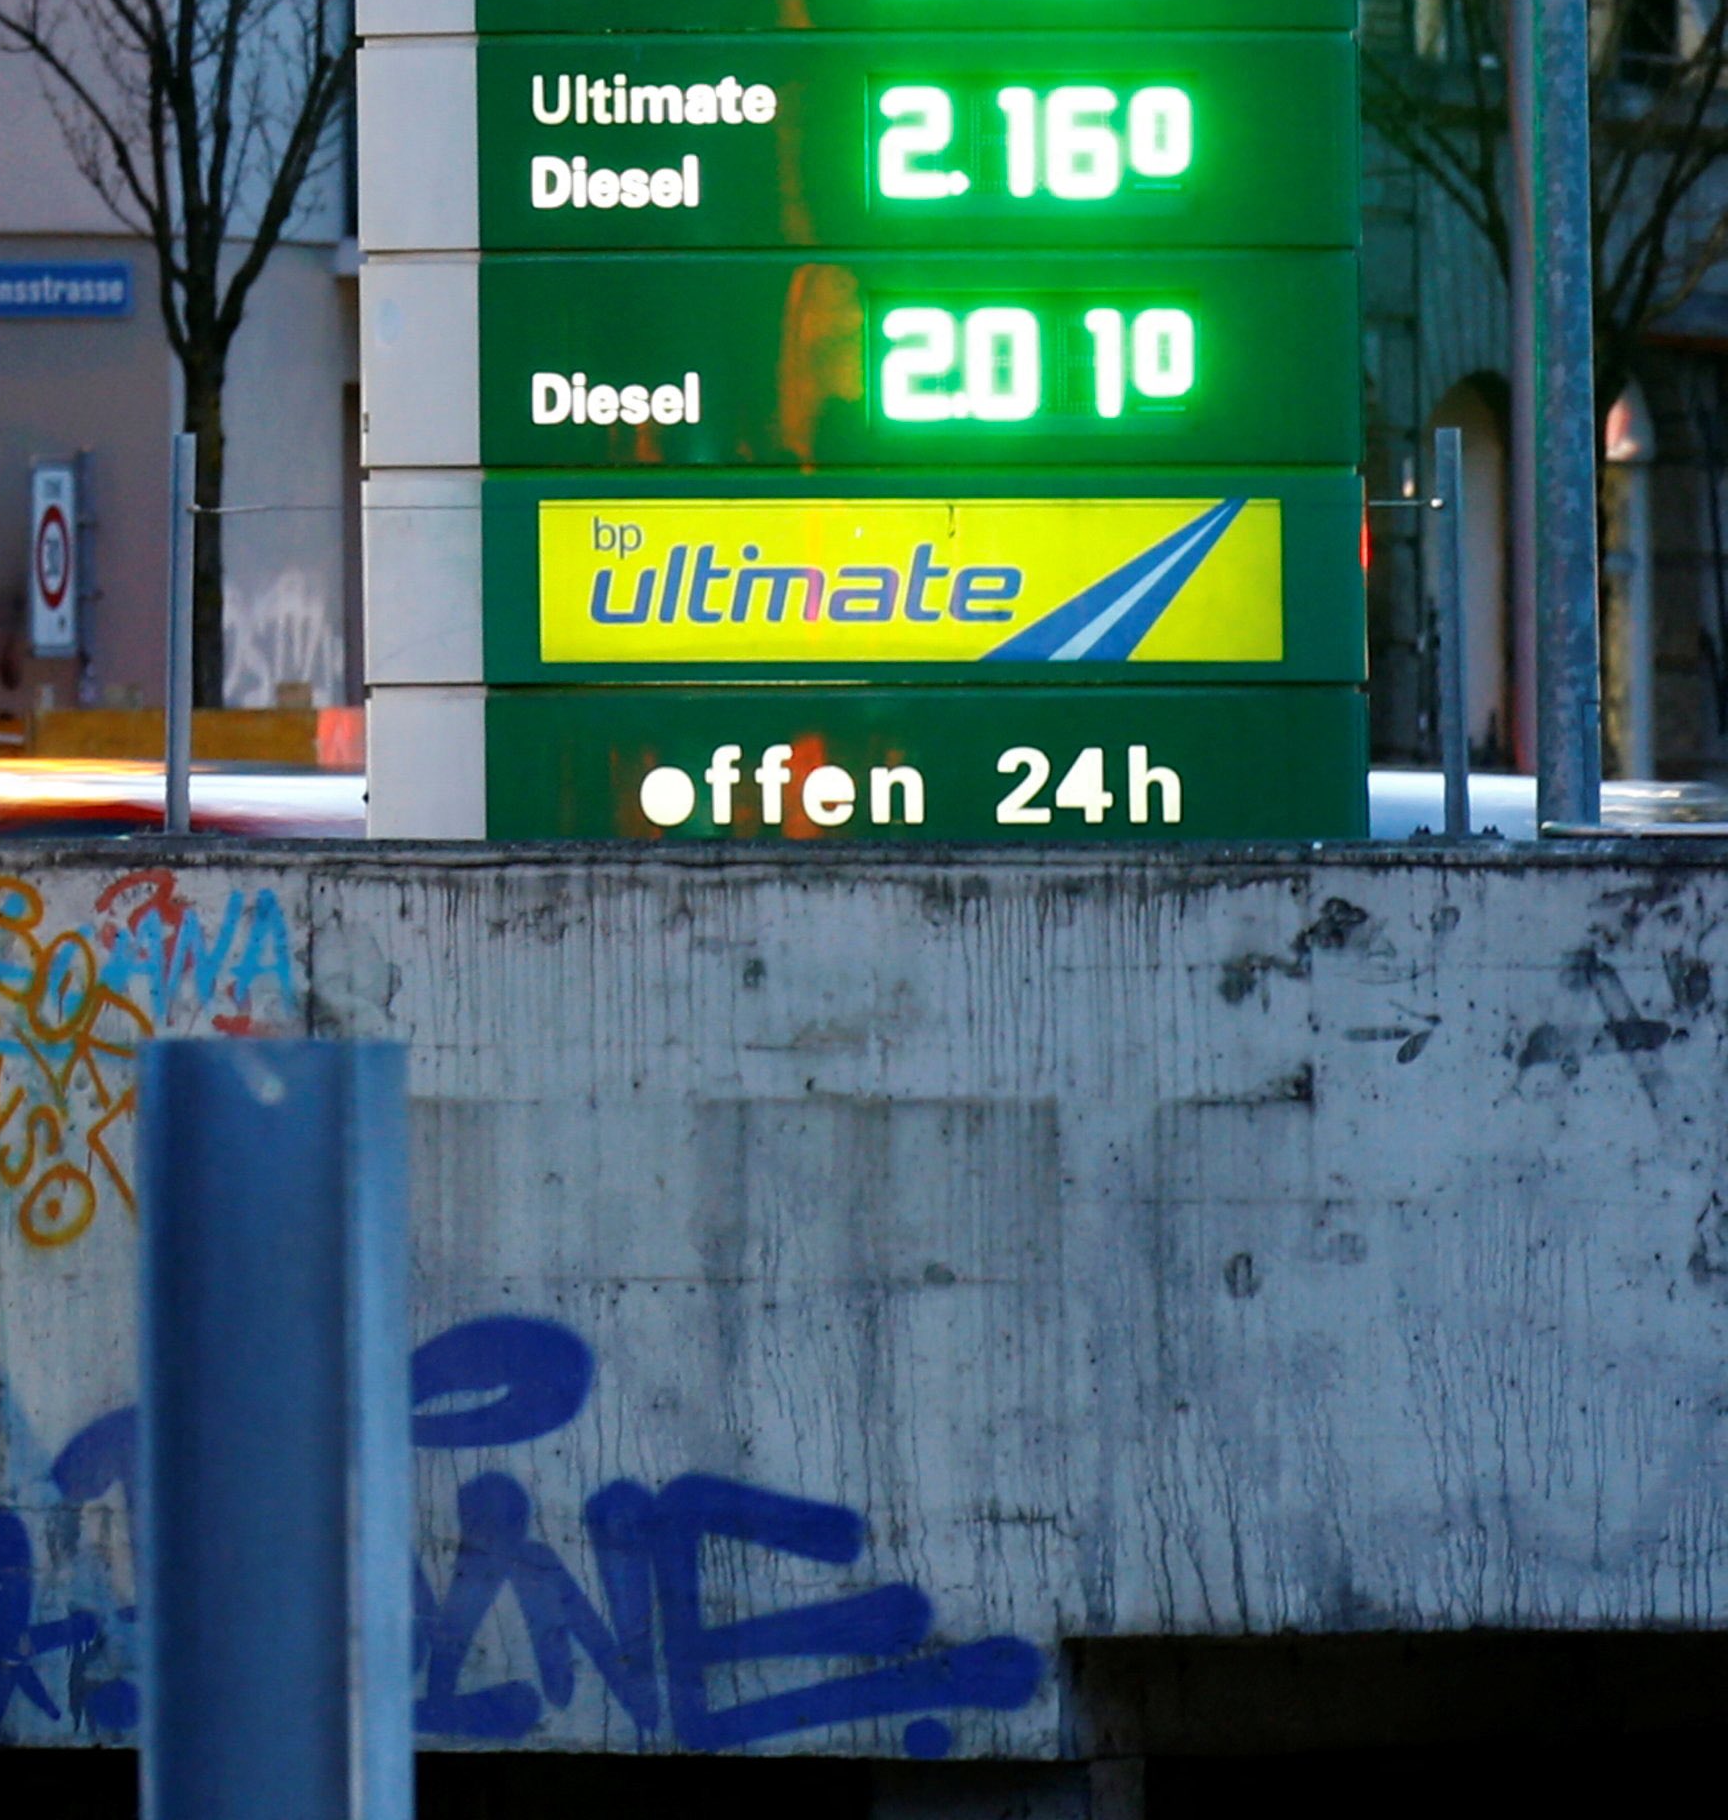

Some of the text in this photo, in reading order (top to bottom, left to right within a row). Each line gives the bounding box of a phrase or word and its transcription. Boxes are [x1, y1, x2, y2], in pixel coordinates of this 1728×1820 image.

[531, 74, 778, 125] Ultimate
[530, 153, 700, 209] Diesel
[530, 371, 701, 425] Diesel
[592, 516, 643, 559] bp
[590, 542, 1023, 624] ultimate
[639, 744, 1182, 827] offen 24h
